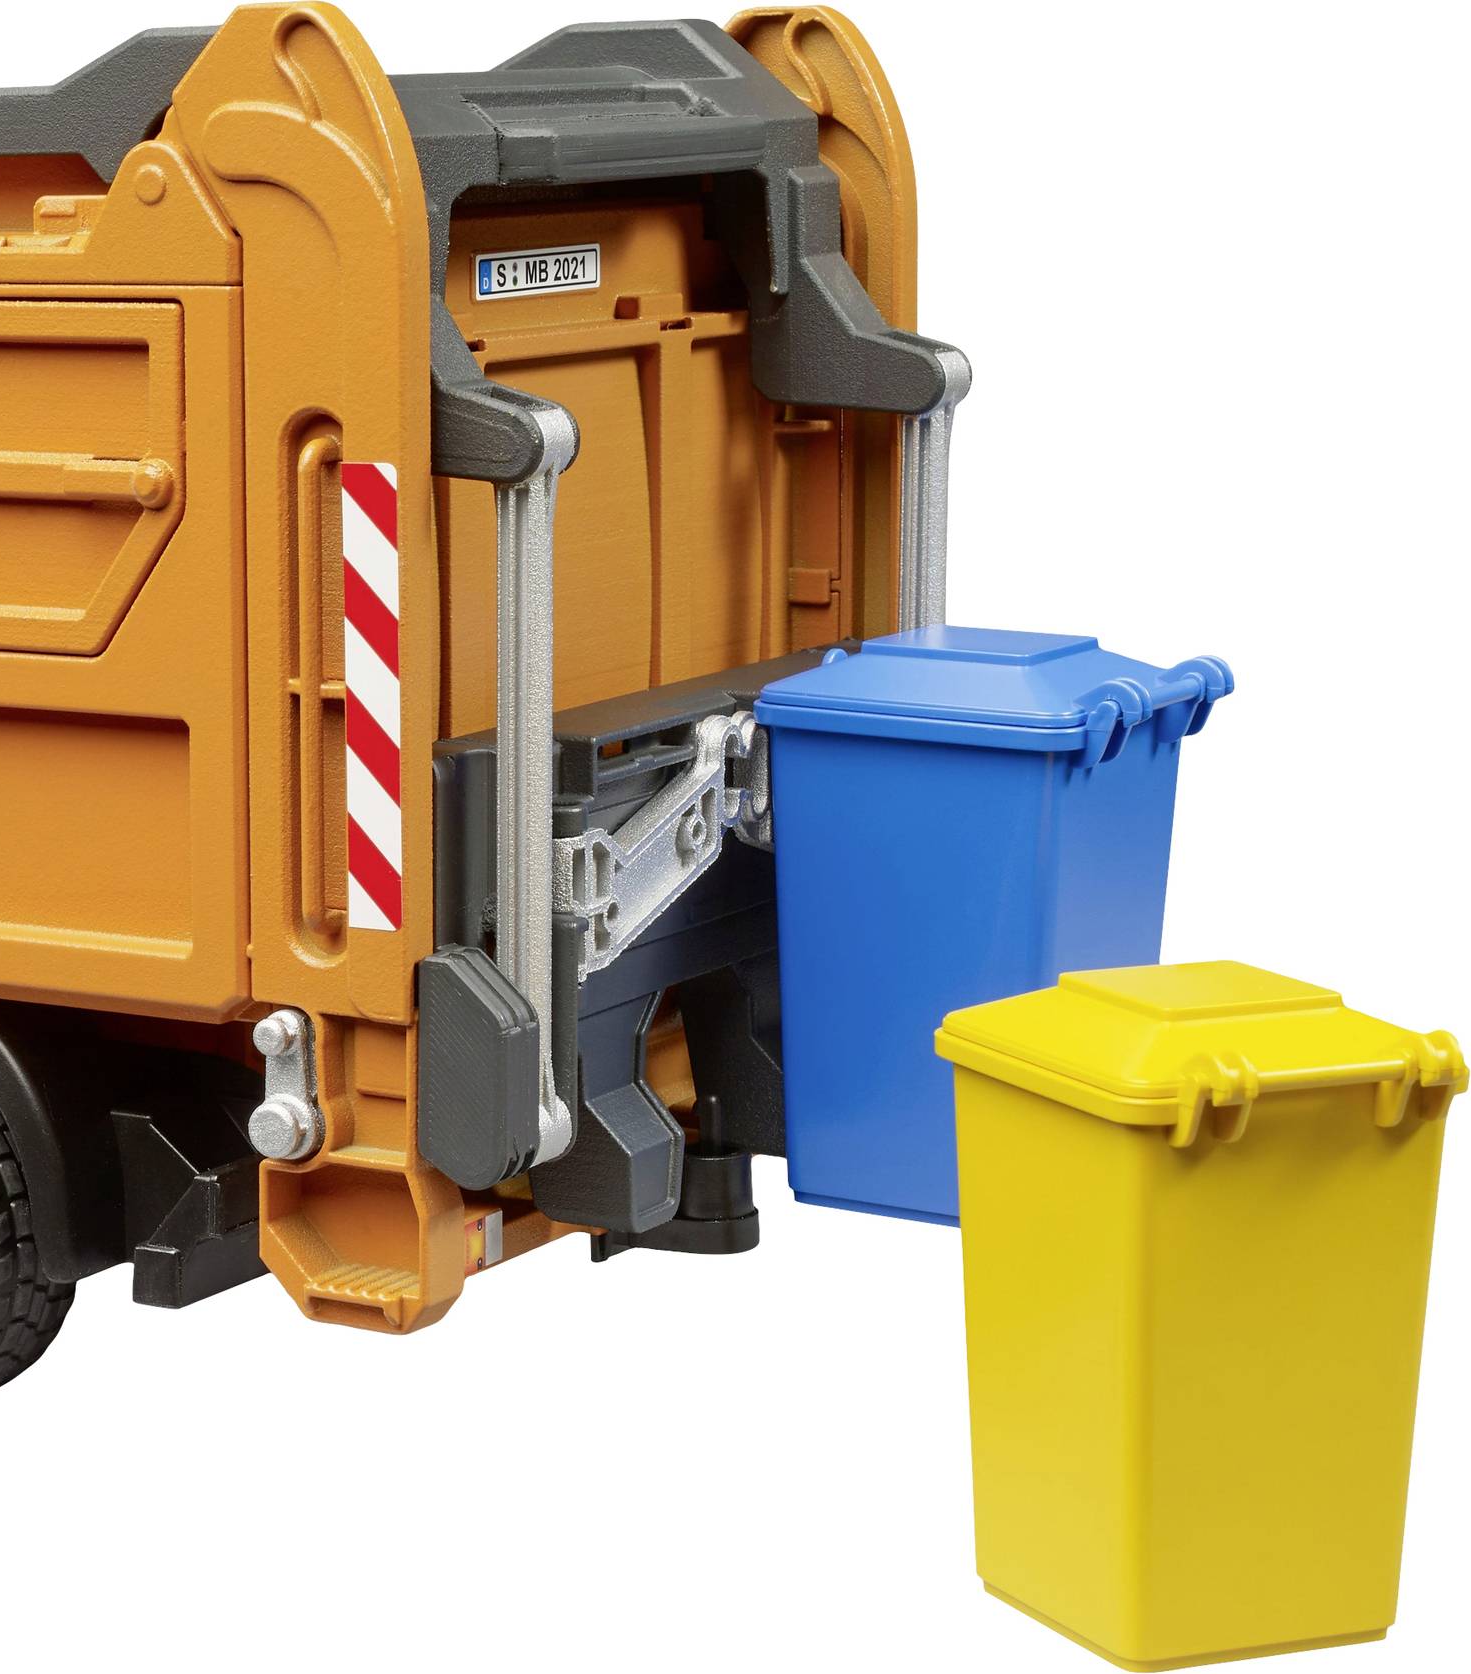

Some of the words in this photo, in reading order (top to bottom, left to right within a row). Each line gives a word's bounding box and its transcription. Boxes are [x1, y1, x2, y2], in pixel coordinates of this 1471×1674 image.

[496, 263, 507, 287] S
[525, 259, 549, 284] MB
[553, 255, 586, 281] 2021
[483, 277, 489, 289] D
